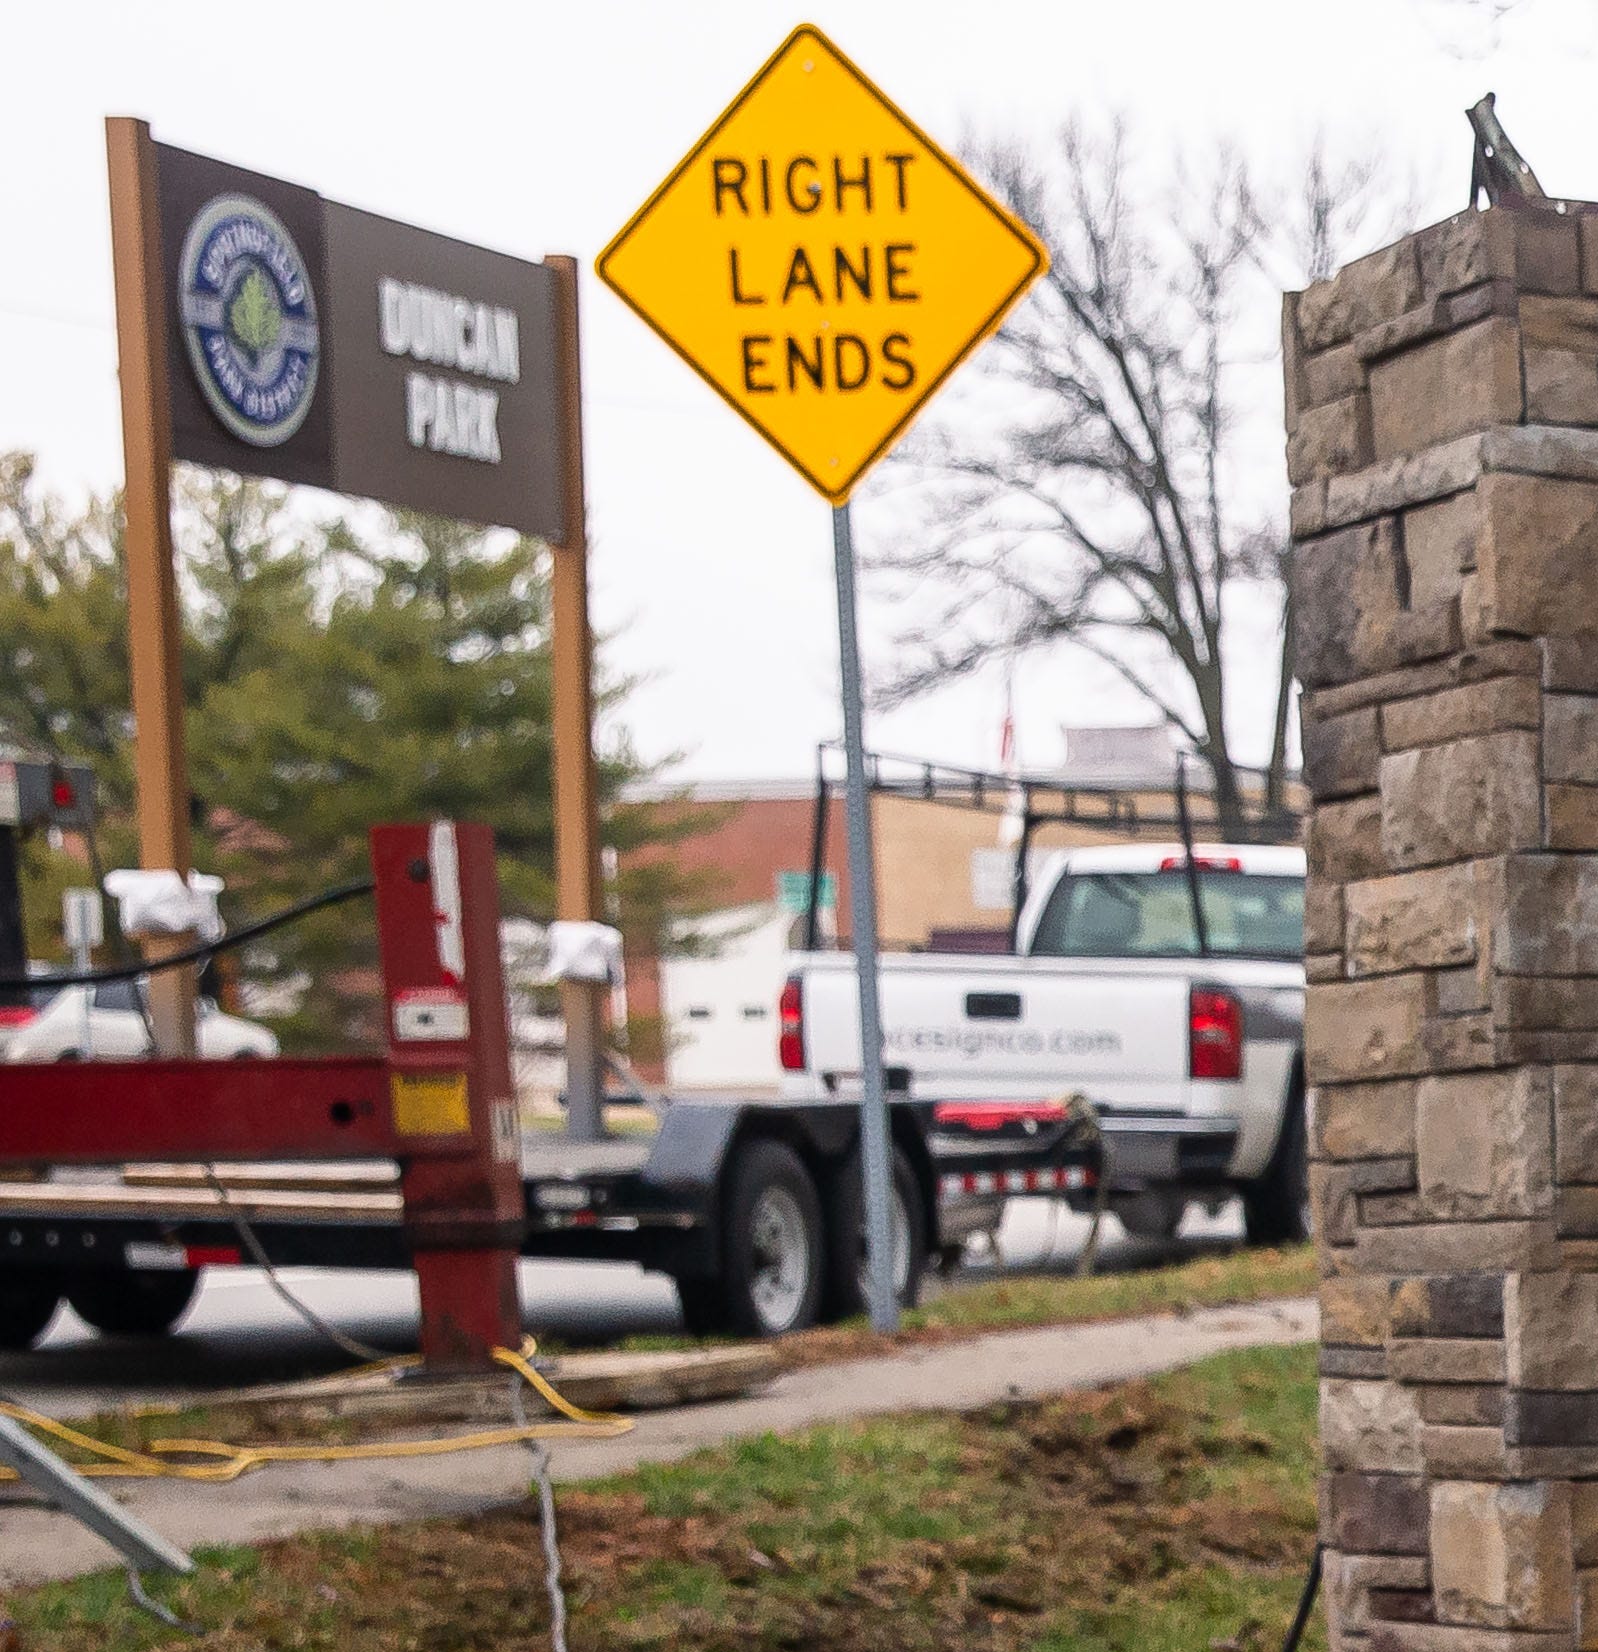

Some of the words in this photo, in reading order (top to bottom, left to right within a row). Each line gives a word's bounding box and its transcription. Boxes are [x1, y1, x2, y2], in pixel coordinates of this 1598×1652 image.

[713, 154, 915, 215] RIGHT
[730, 243, 920, 304] LANE
[378, 276, 520, 385] DUNCAN
[742, 334, 916, 392] ENDS
[407, 371, 502, 465] PARK
